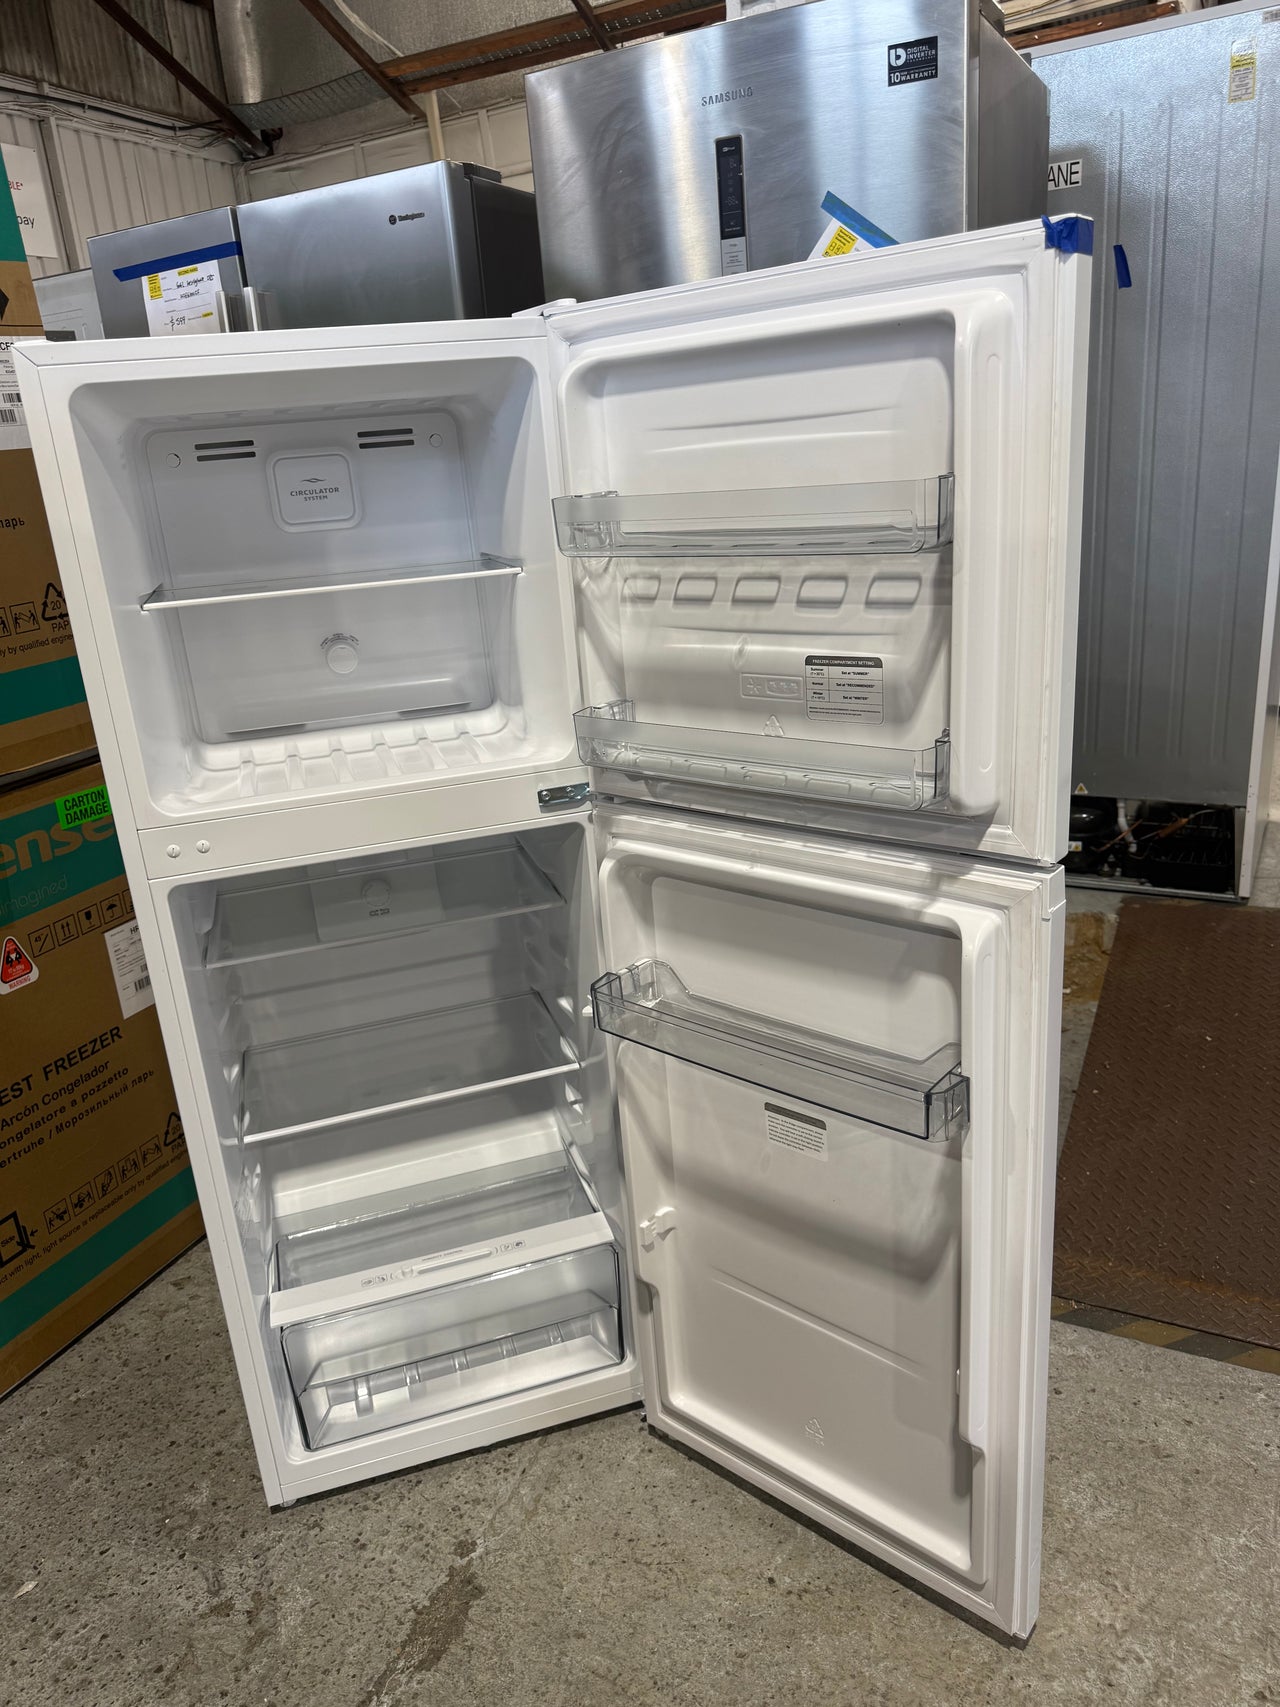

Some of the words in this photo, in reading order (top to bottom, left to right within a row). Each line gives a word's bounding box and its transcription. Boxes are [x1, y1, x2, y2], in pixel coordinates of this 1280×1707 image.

[890, 72, 900, 83] 10
[901, 70, 936, 81] WARRANTY
[701, 86, 753, 107] SAMSUNG
[290, 487, 340, 496] CIRCULATOR
[51, 600, 61, 610] 20
[51, 621, 69, 633] PAP
[7, 645, 17, 656] by
[19, 636, 50, 652] qualified
[63, 788, 105, 812] CARTON
[65, 801, 108, 825] DAMAGE
[42, 1026, 122, 1081] FREEZER
[1, 1102, 39, 1131] Arcón
[42, 1060, 110, 1106] Congelador
[55, 1083, 129, 1134] Морозильный
[131, 1069, 154, 1088] ларь
[0, 1106, 66, 1150] ongelatore
[71, 1099, 77, 1107] a
[81, 1067, 129, 1102] pozzetto
[0, 1136, 44, 1169] ertruhe
[8, 1263, 24, 1278] with
[43, 1240, 58, 1256] light
[58, 1224, 81, 1240] source
[88, 1194, 123, 1221] replaceable
